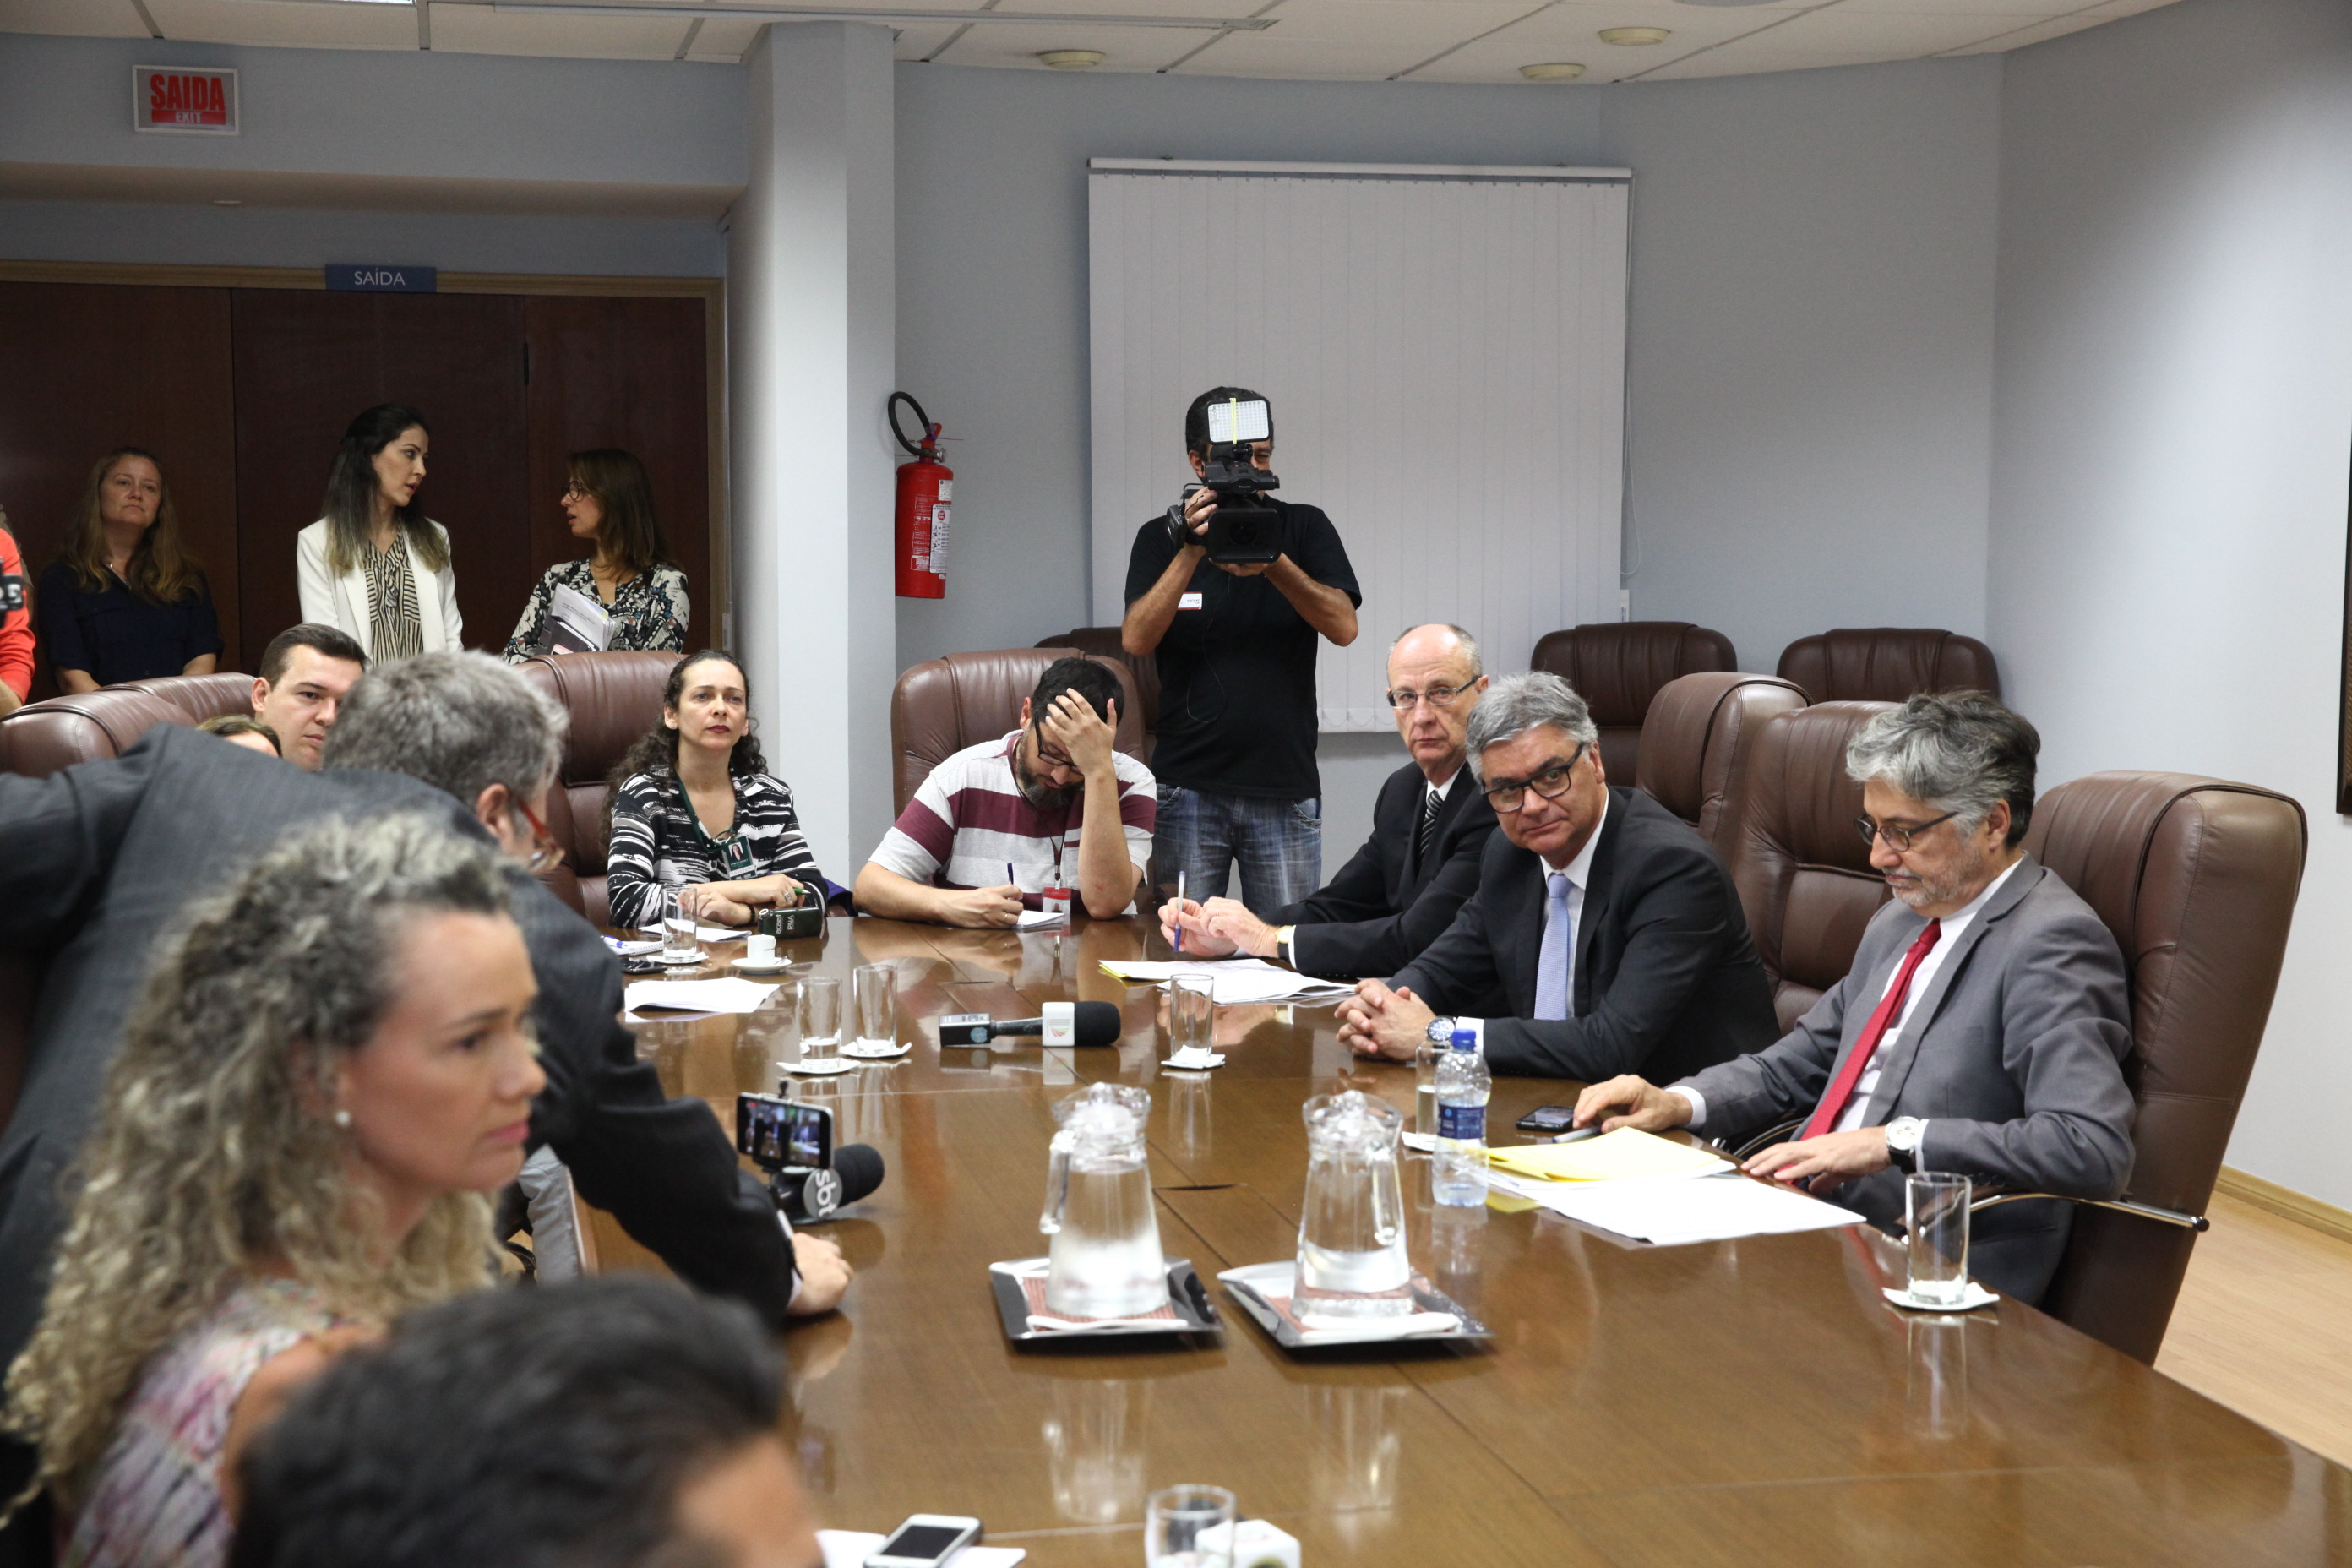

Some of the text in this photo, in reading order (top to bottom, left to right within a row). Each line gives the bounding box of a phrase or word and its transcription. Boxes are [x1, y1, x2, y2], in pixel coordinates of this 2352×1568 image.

[150, 74, 226, 111] SAIDA
[176, 112, 203, 123] EXIT
[355, 267, 406, 286] SAÍDA
[815, 1169, 836, 1217] sbt
